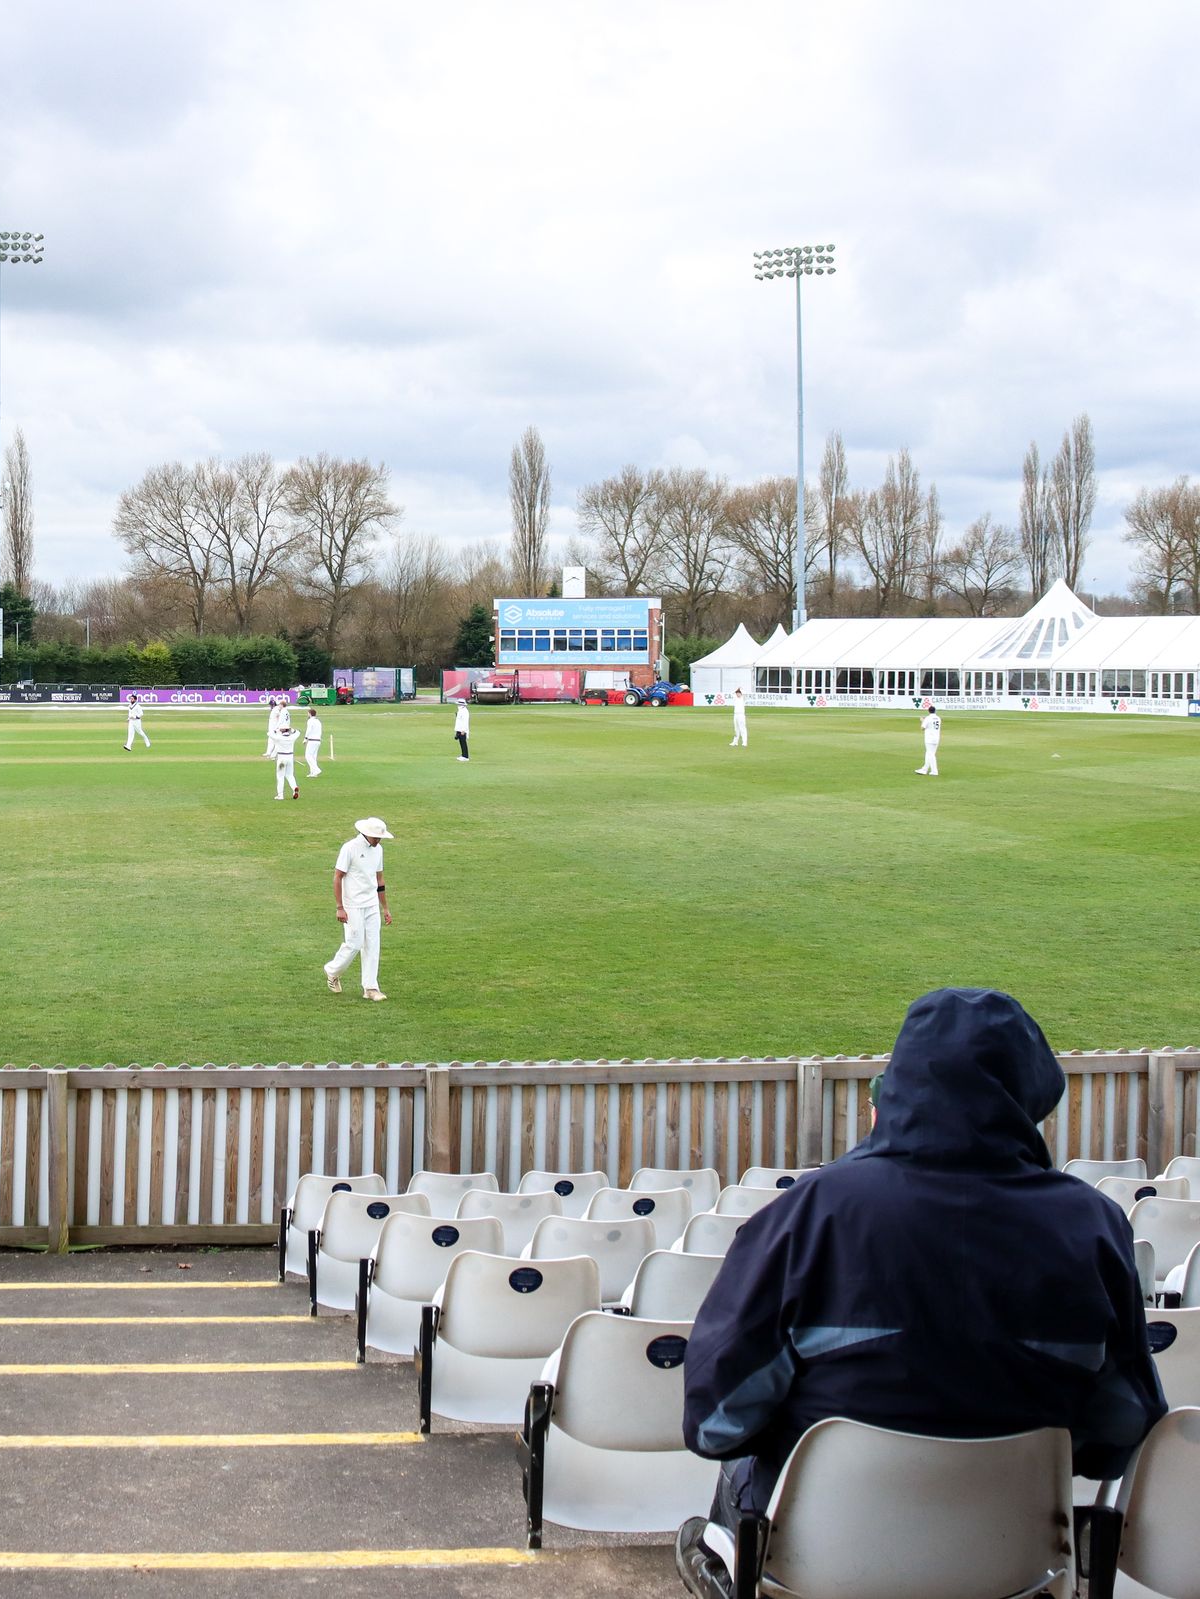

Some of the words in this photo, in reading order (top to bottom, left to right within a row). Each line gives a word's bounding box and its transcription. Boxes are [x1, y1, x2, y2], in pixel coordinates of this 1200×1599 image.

[526, 608, 564, 617] Absolute
[170, 691, 202, 702] cinch
[214, 691, 246, 703] cinch
[933, 721, 939, 730] 15
